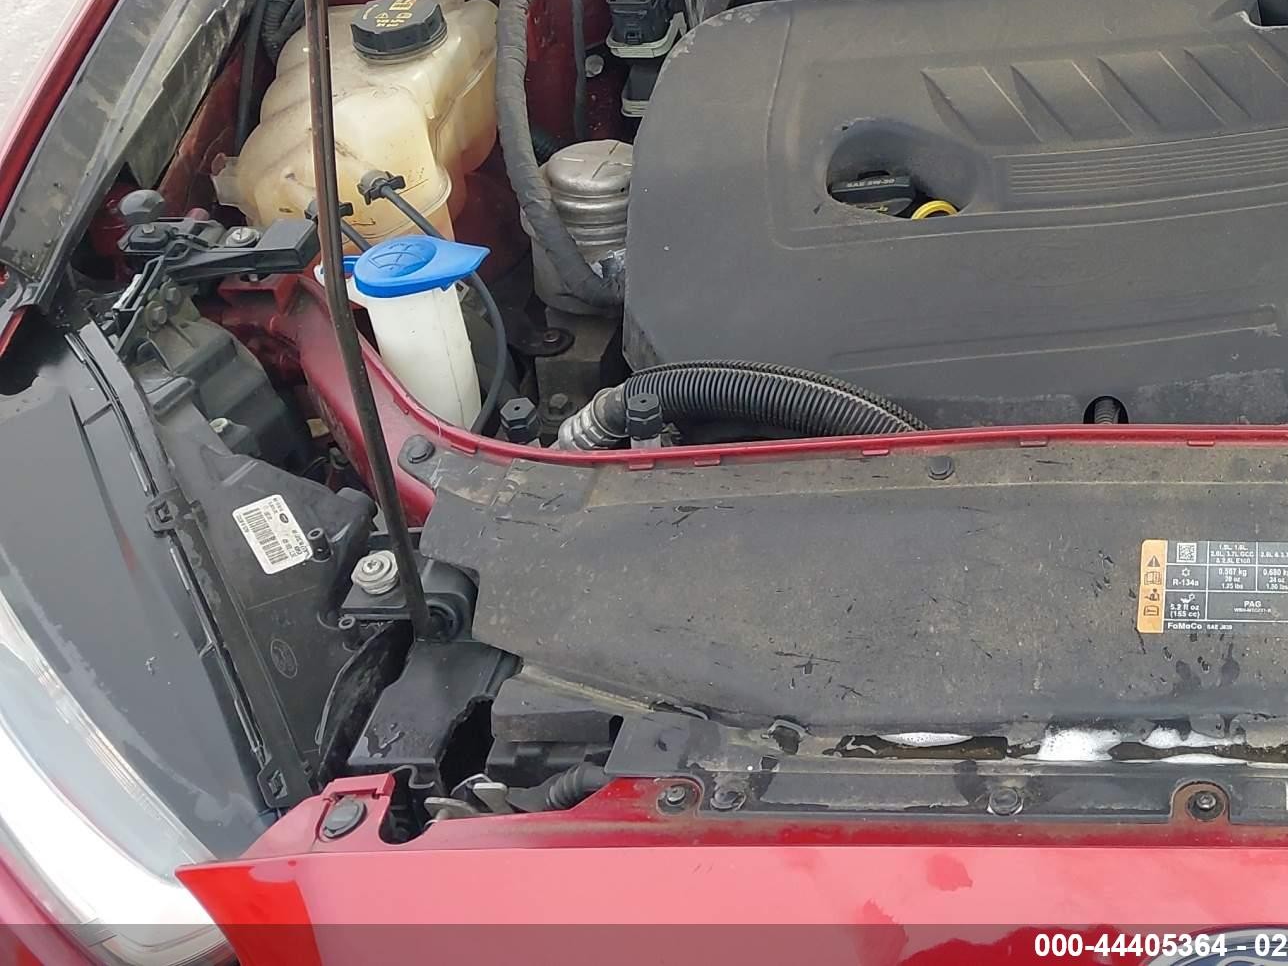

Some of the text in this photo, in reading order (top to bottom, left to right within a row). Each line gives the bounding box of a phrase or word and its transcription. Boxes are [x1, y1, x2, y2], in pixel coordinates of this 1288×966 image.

[1238, 568, 1247, 577] kg
[1172, 578, 1199, 586] R-134a
[1170, 603, 1182, 611] 5.2
[1244, 600, 1262, 608] PAG
[1170, 610, 1187, 618] (155
[1167, 622, 1203, 630] FoMoCo
